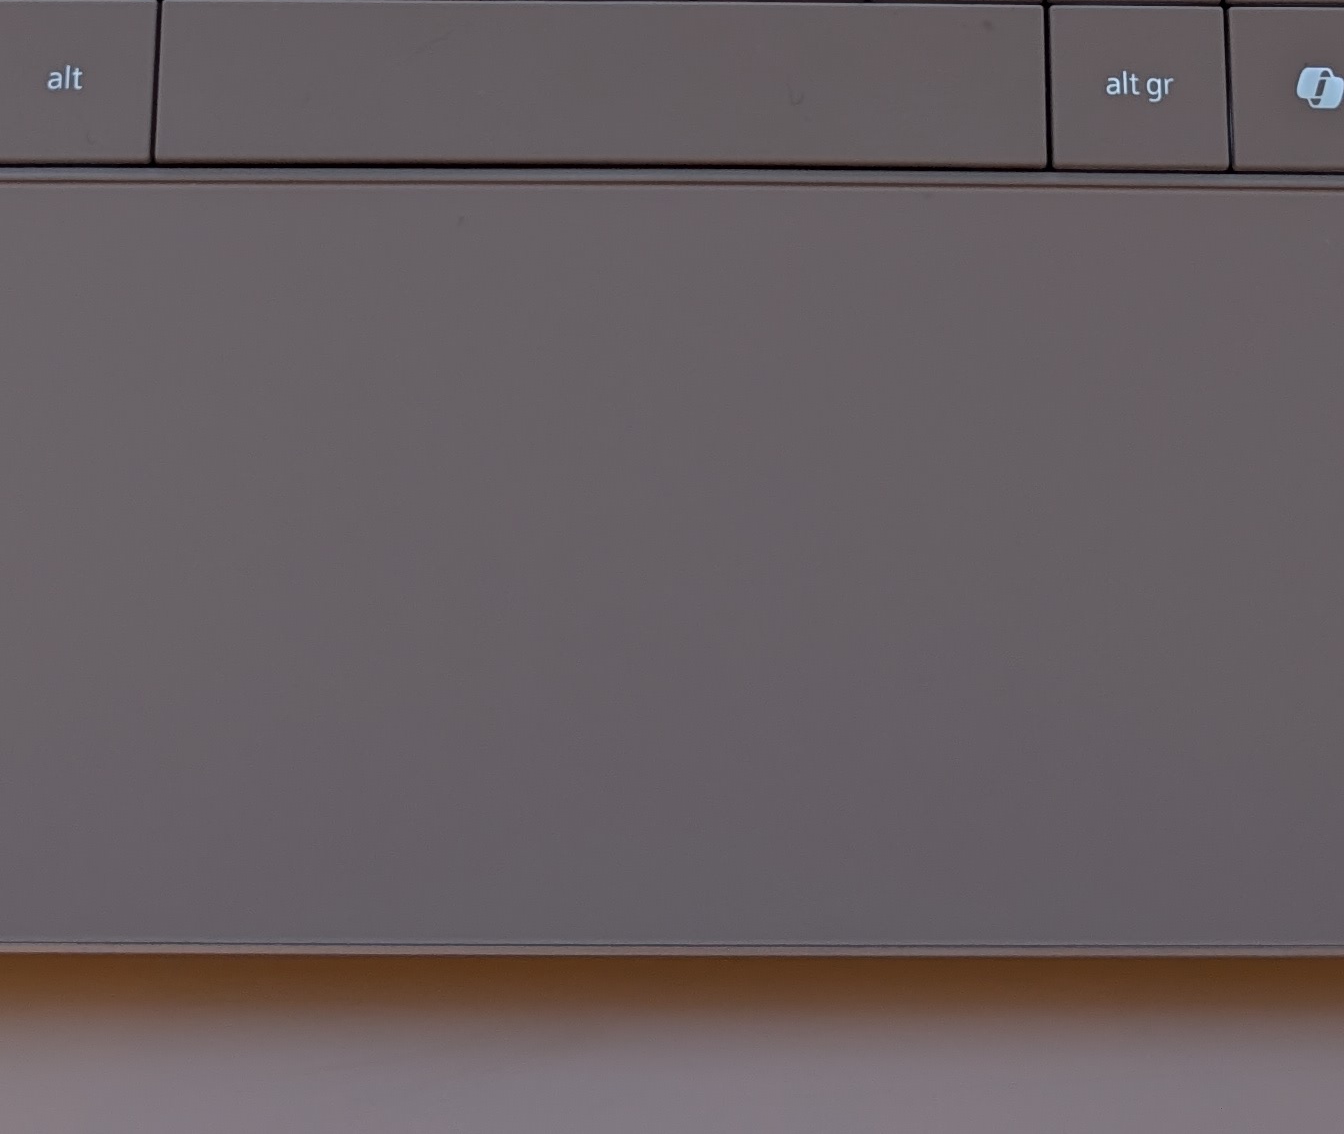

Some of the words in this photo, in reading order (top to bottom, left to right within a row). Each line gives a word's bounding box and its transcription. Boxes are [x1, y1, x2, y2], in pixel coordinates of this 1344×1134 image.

[47, 64, 83, 90] alt
[1106, 70, 1140, 96] alt
[1146, 77, 1174, 103] gr
